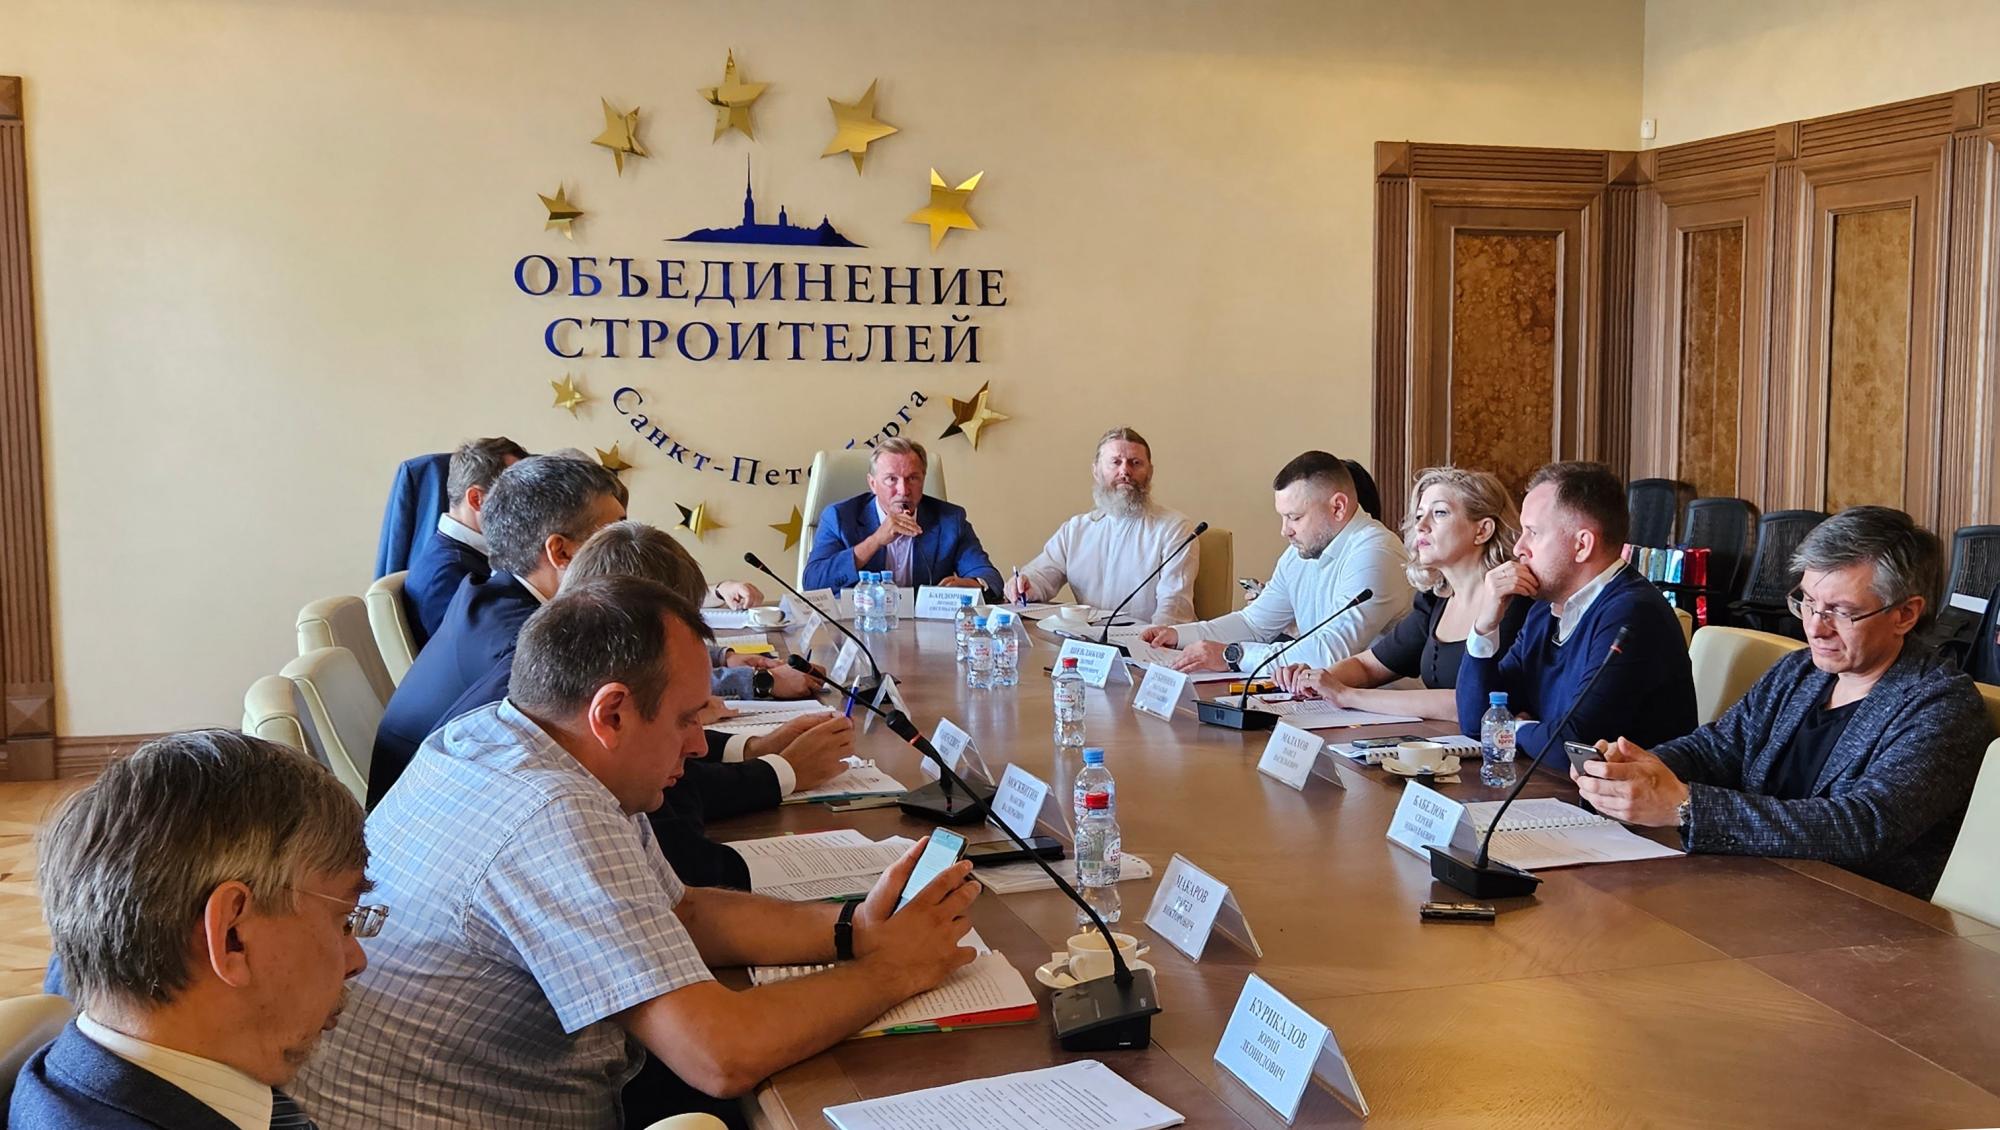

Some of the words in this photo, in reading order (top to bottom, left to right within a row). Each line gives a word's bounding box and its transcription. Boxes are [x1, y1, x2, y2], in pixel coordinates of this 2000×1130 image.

[514, 254, 1008, 308] ОБЪЕДИНЕНИЕ
[544, 314, 981, 363] СТРОИТЕЛЕЙ
[1413, 795, 1447, 820] БАБЕЛЮК
[1415, 813, 1434, 829] СЕРГЕЙ
[1176, 874, 1209, 903] МАКАРОВ
[1162, 904, 1195, 932] ВИКТОРОВИЧ
[1249, 997, 1309, 1050] КУРИКАЛОВ
[1257, 1030, 1281, 1055] ЮРИЙ
[1240, 1039, 1286, 1081] ЛЕОНИДОВИЧ
